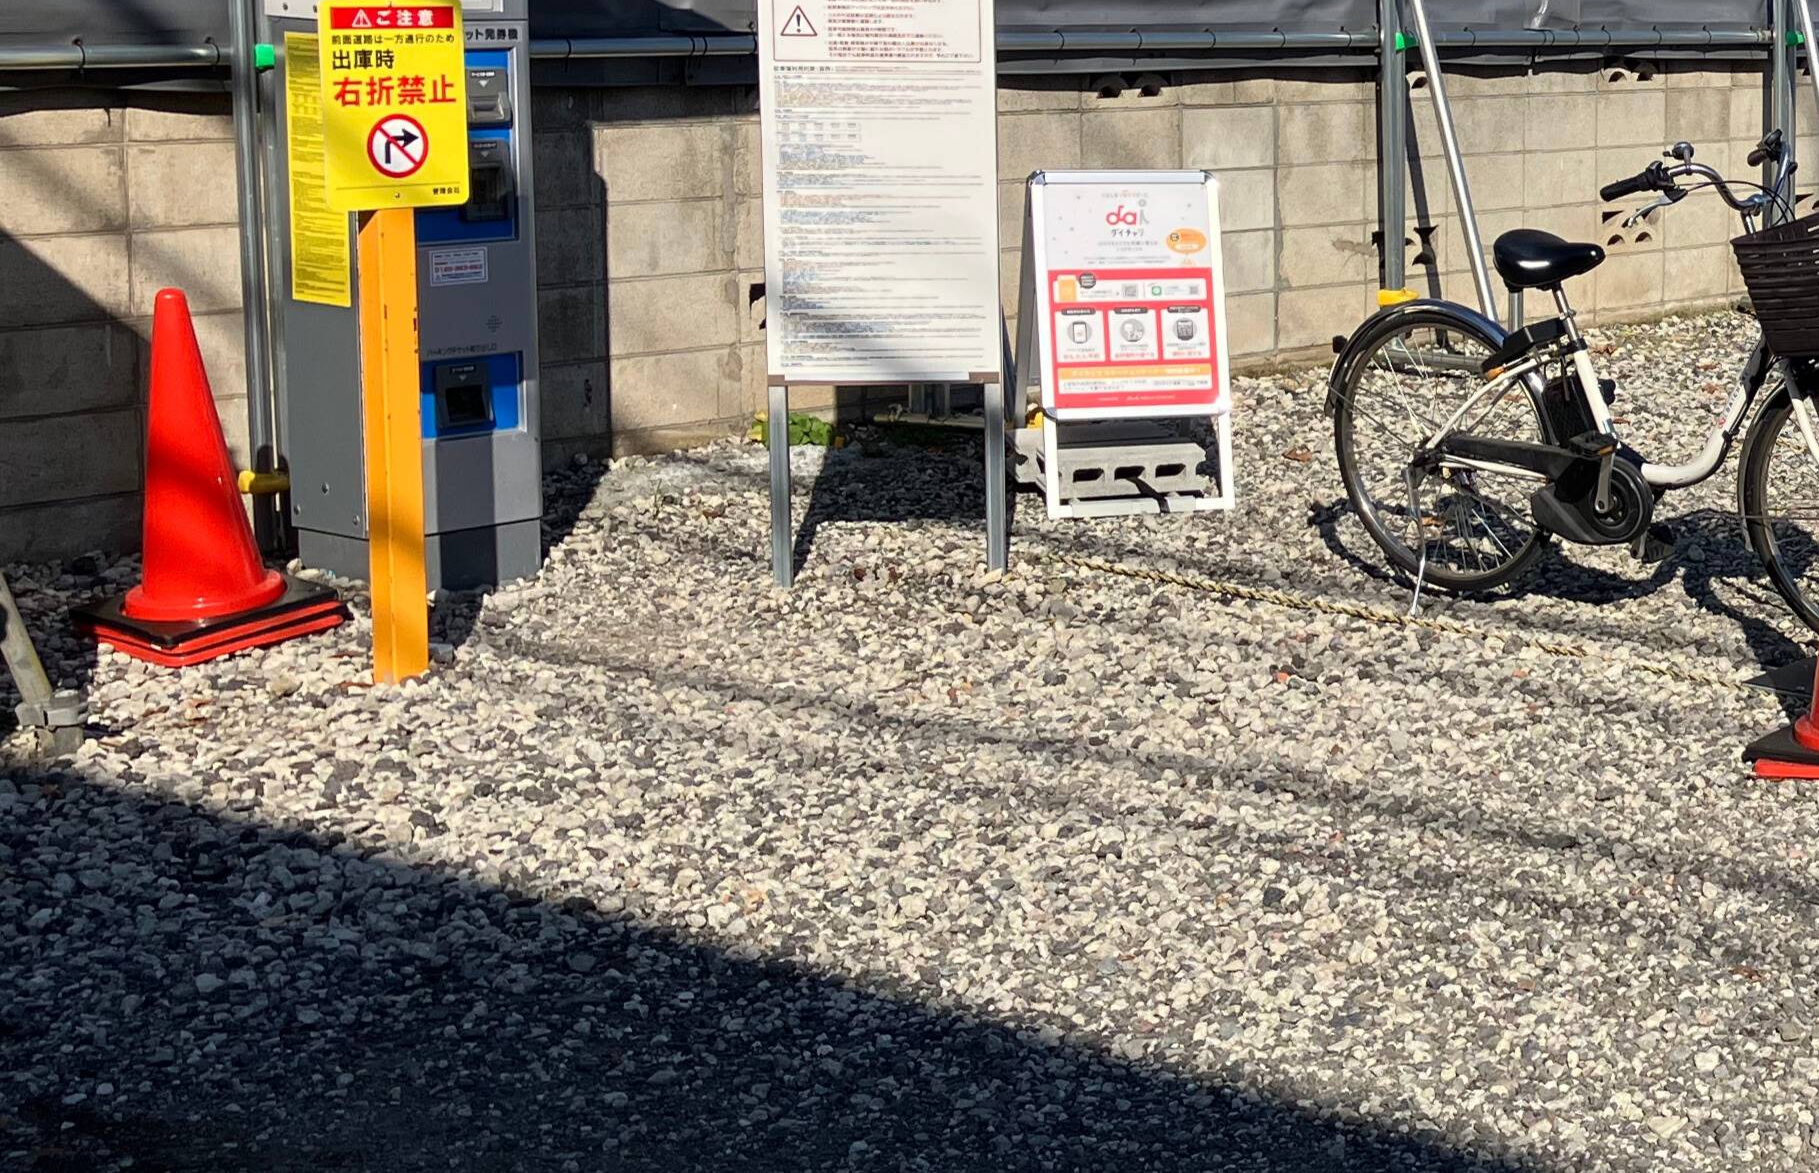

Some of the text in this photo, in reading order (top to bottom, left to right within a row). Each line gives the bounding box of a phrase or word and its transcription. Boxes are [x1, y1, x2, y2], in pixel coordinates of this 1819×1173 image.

[375, 9, 434, 26] ご注意
[331, 33, 455, 45] 前面道路は一方通行のため
[332, 49, 395, 70] 出庫時
[333, 74, 456, 107] 右折禁止
